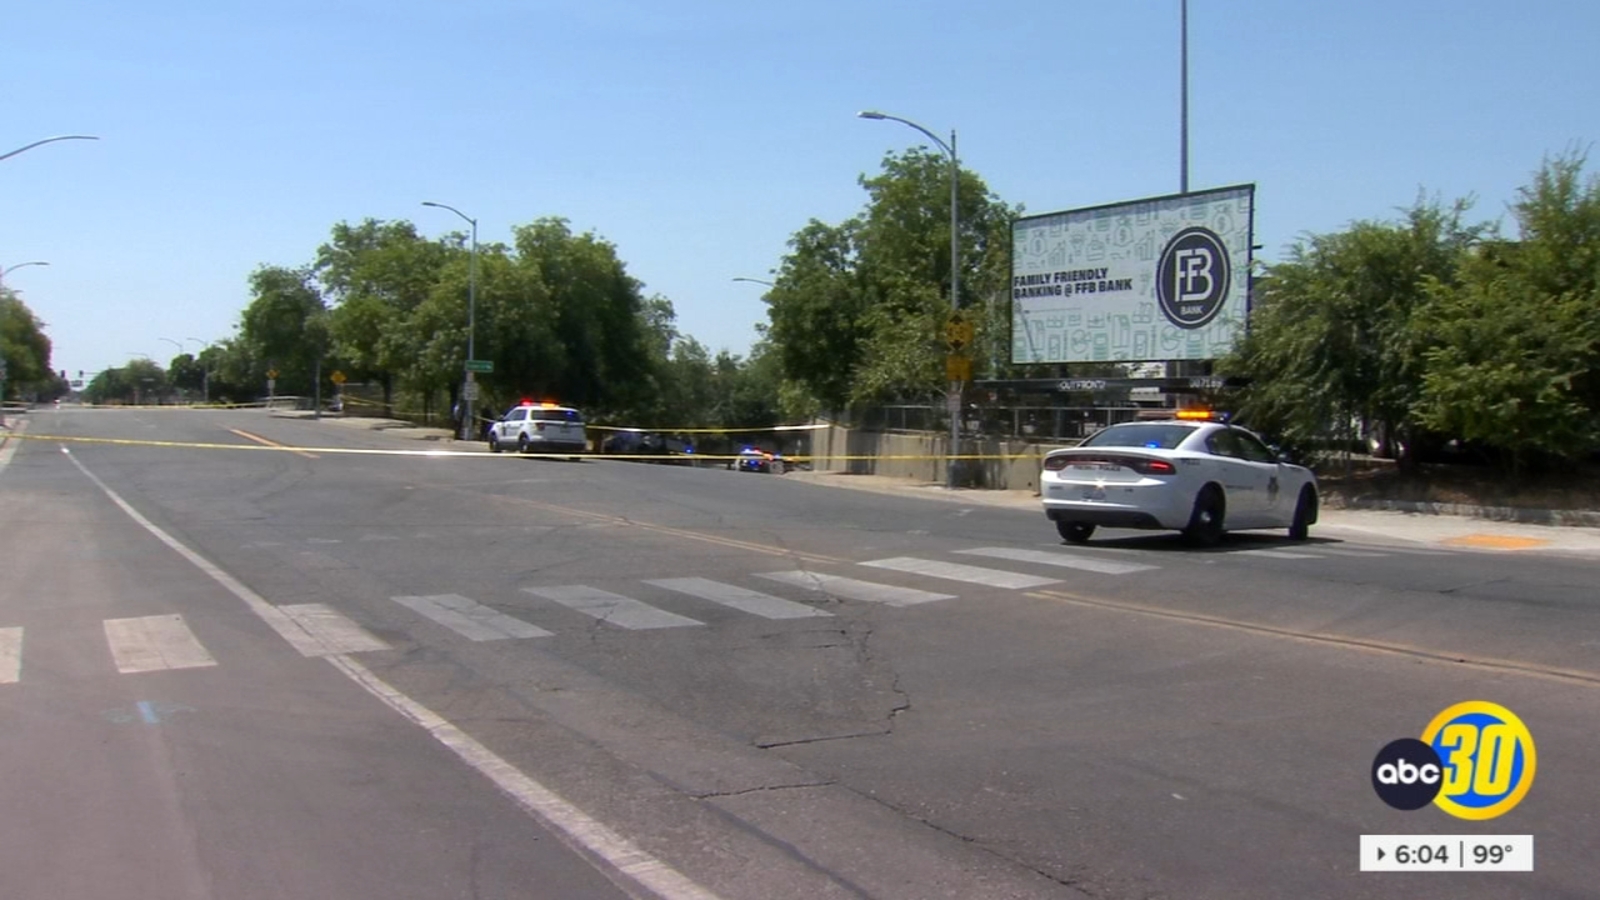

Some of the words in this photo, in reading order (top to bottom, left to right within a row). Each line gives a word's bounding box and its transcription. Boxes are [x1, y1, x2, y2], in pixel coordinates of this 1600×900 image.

[1014, 273, 1051, 287] FAMILY
[1054, 268, 1108, 283] FRIENDLY
[1014, 285, 1062, 299] BANKING
[1064, 285, 1072, 297] @
[1075, 282, 1096, 294] FFB
[1099, 278, 1133, 292] BANK
[1180, 305, 1204, 315] BANK
